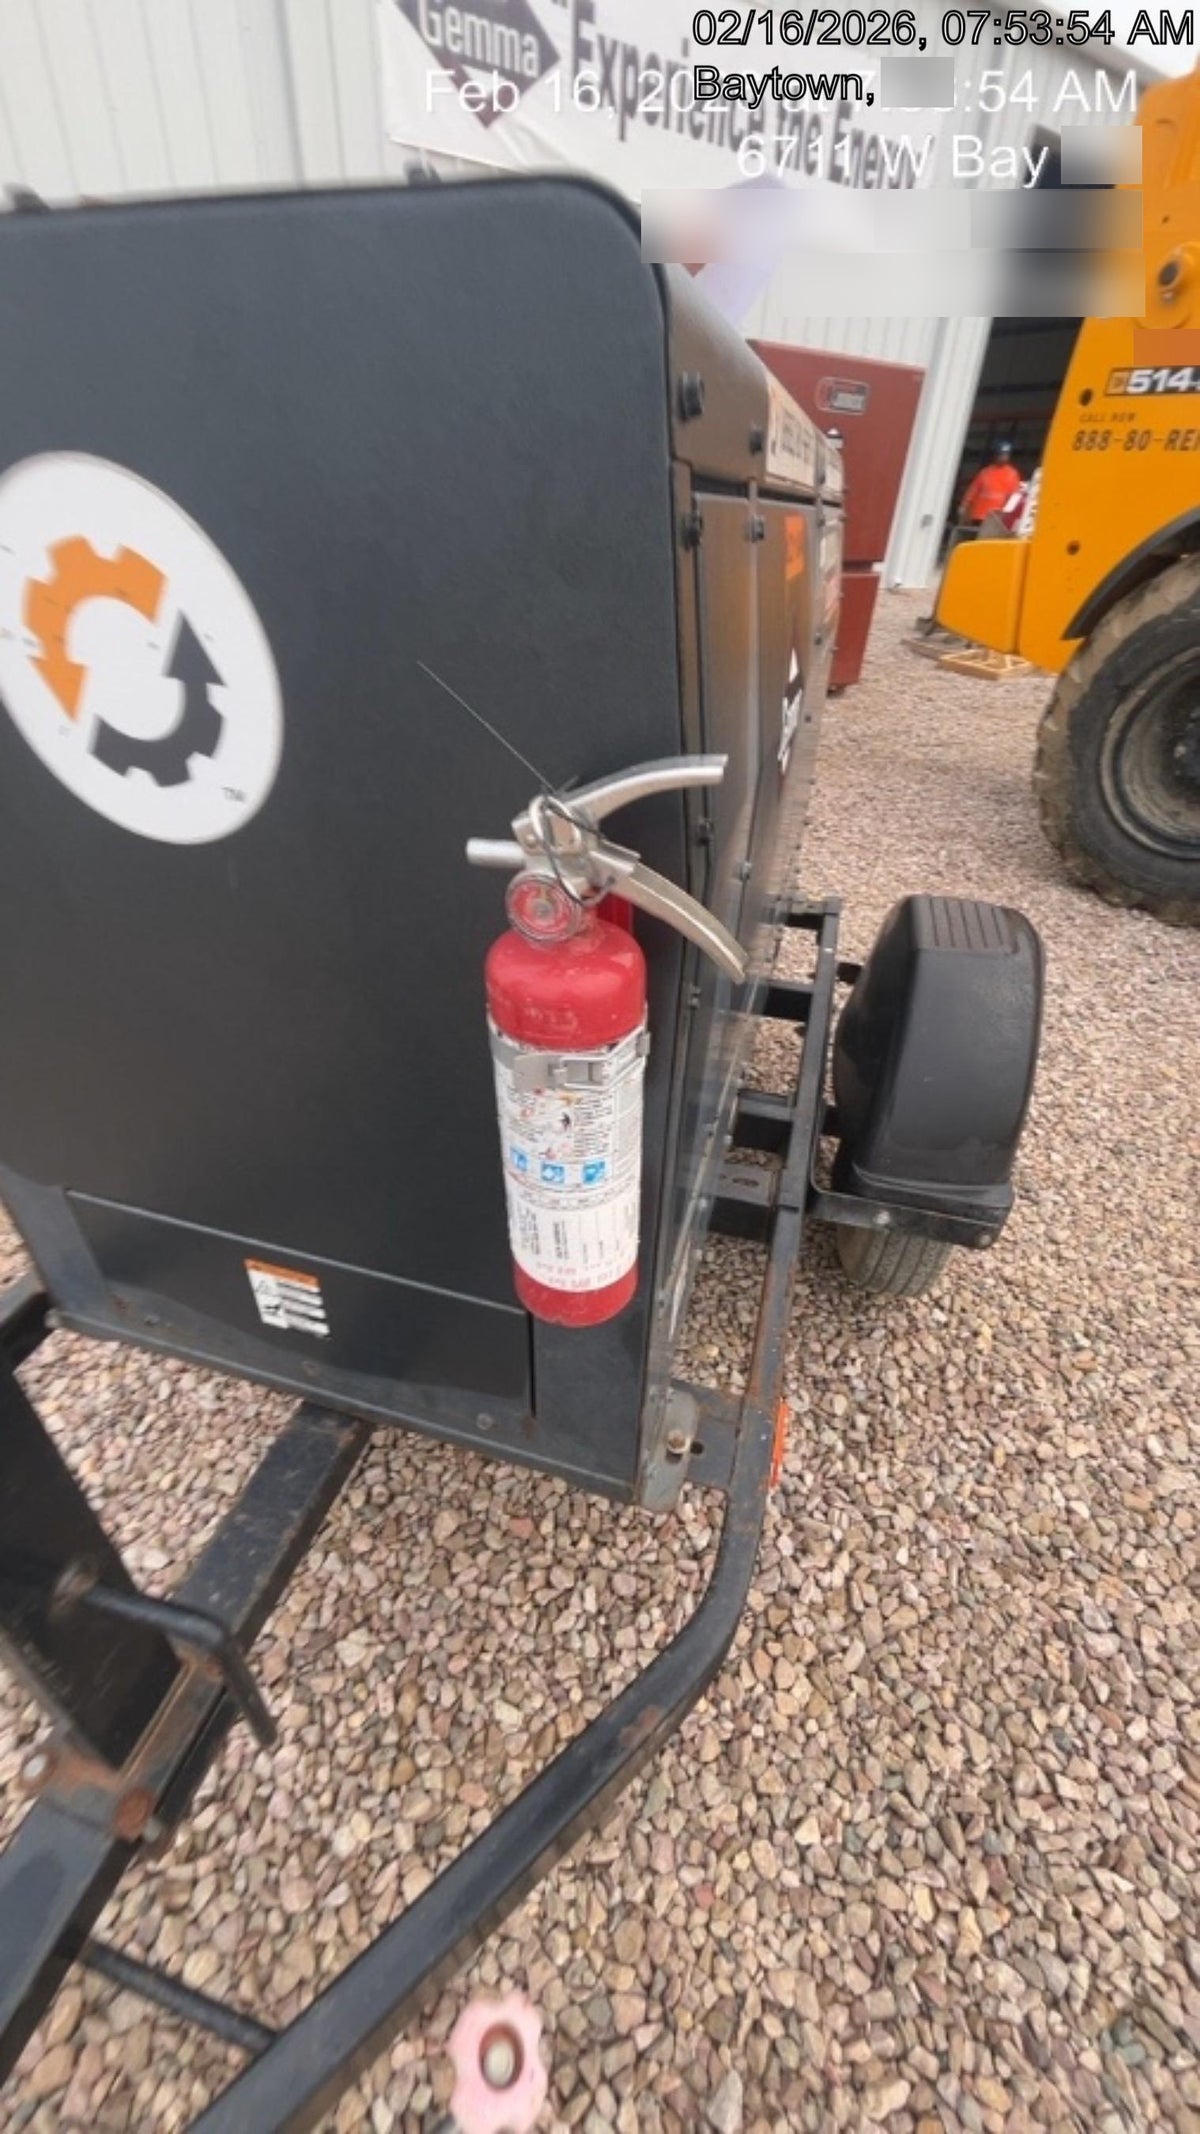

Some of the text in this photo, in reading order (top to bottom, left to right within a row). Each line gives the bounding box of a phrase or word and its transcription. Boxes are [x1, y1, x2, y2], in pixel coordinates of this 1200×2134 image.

[419, 0, 541, 79] Gemma
[551, 0, 766, 152] Experience
[1072, 429, 1200, 452] 888-80-RE
